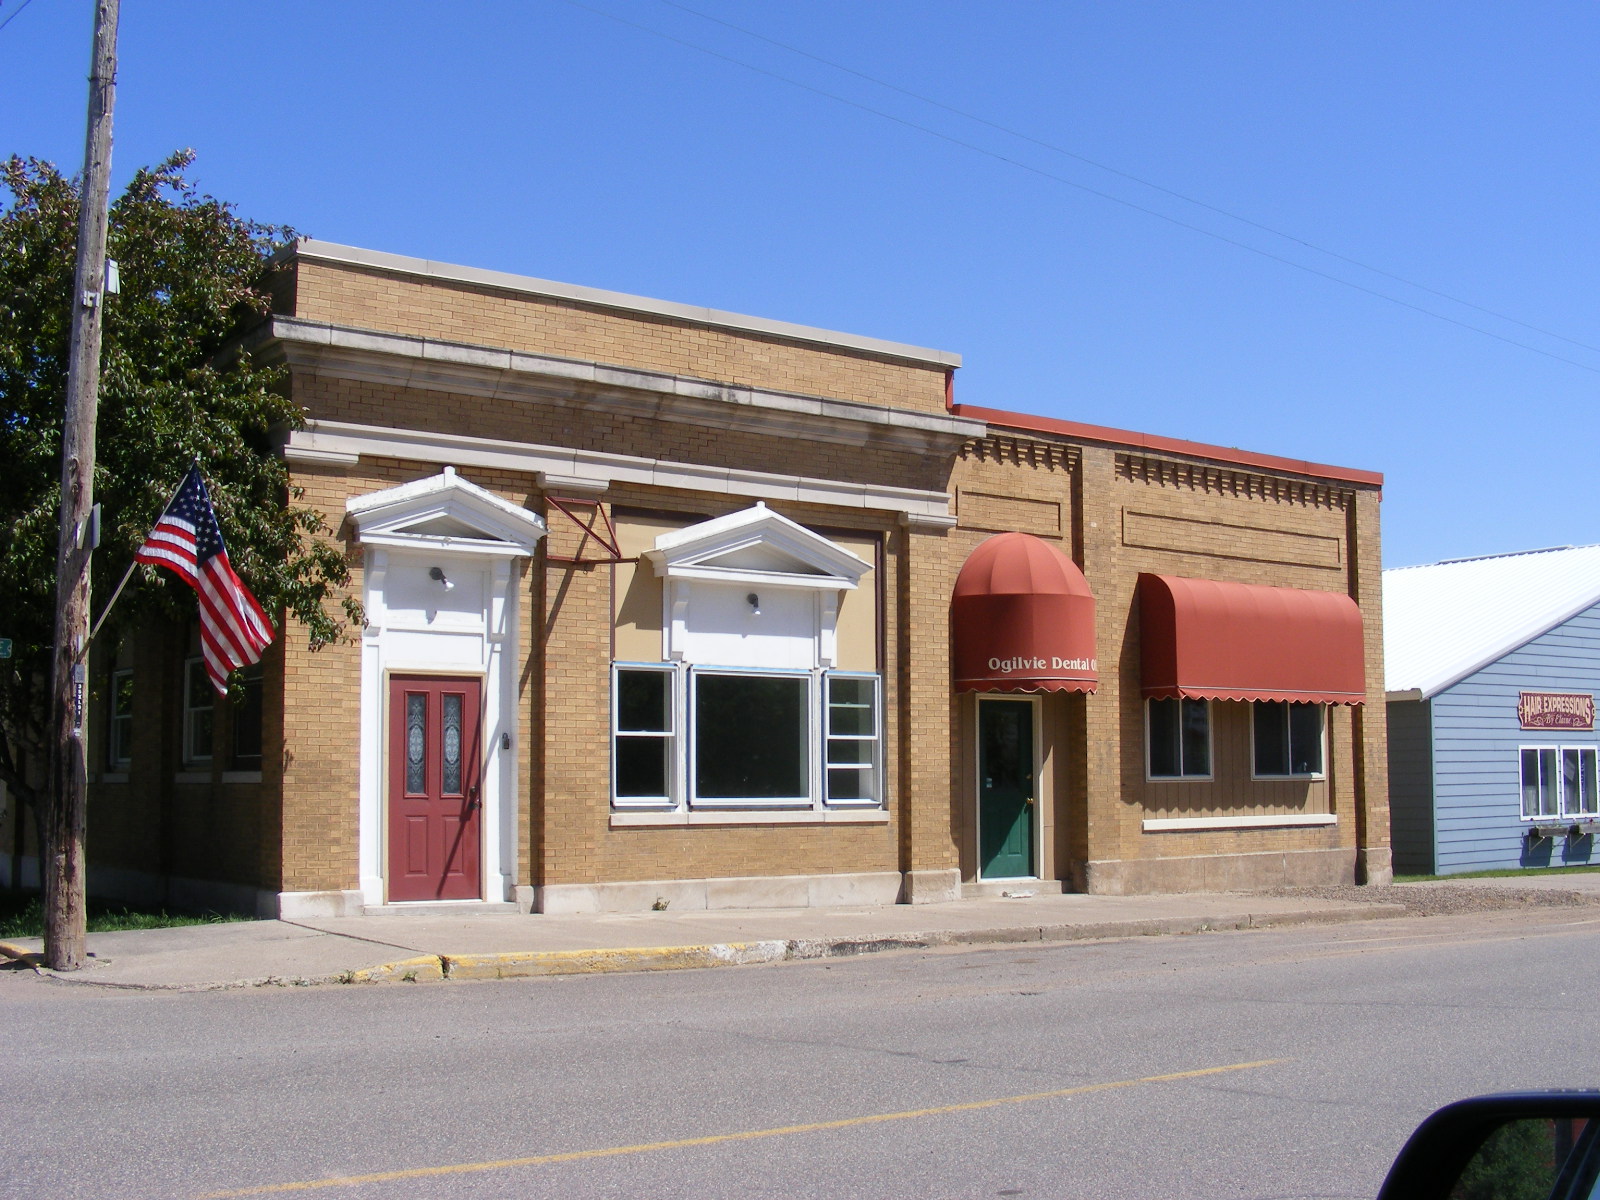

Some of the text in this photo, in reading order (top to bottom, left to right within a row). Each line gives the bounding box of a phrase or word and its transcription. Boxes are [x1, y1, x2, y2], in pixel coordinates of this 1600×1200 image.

[988, 656, 1046, 673] Ogilvie
[1052, 656, 1089, 671] Dental
[1523, 695, 1591, 725] HAIR EXPRESSIONS
